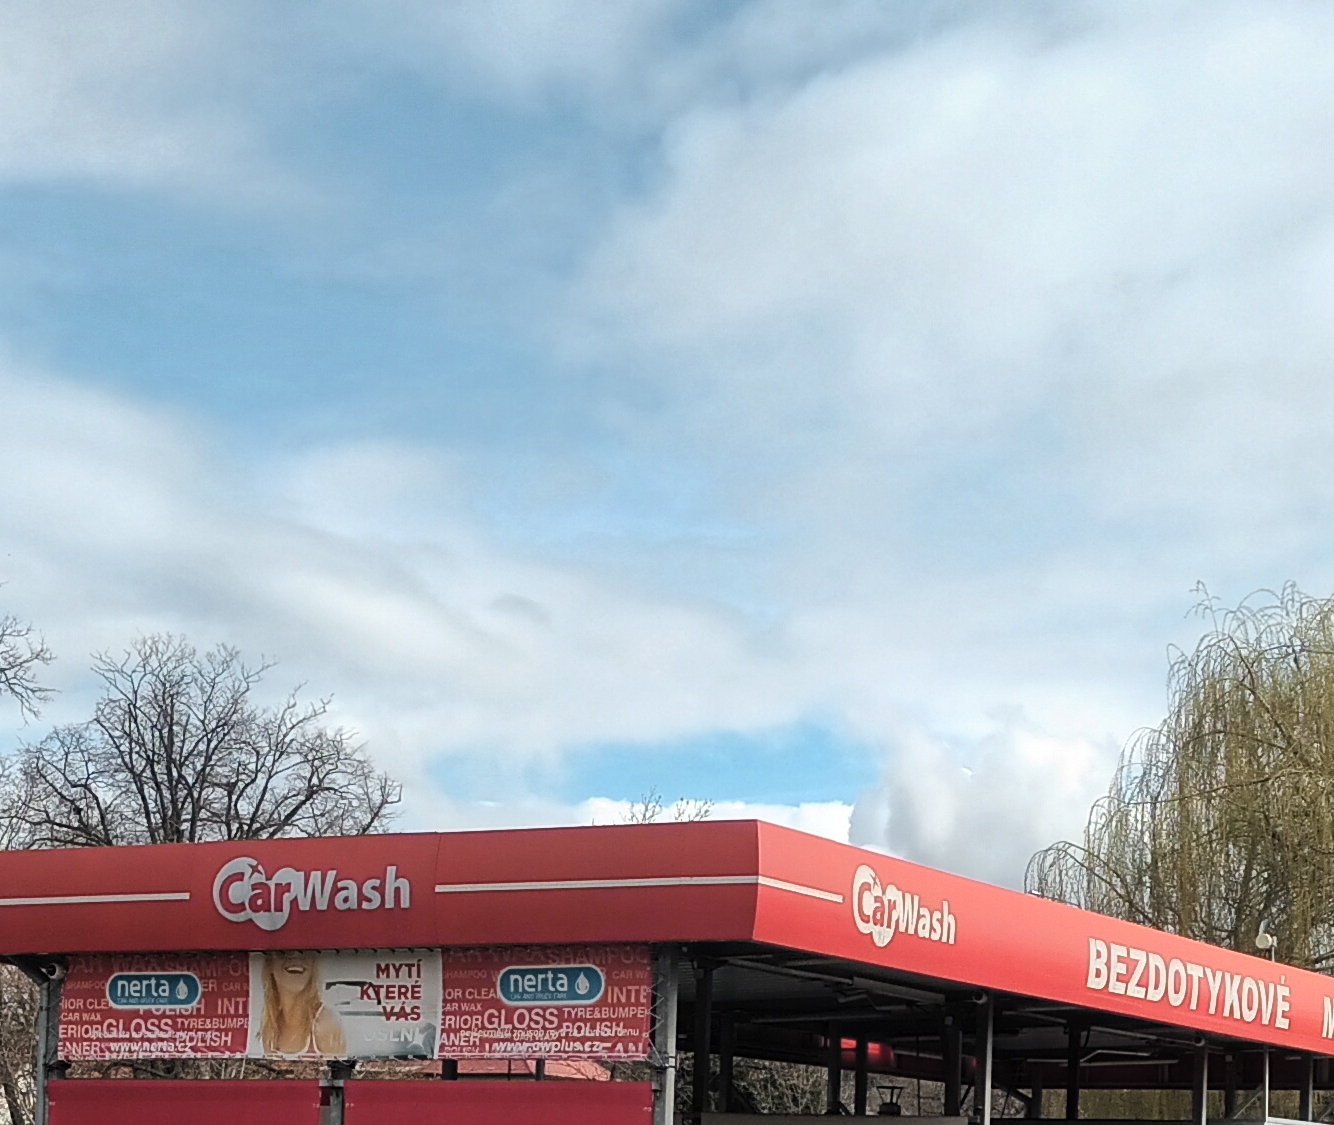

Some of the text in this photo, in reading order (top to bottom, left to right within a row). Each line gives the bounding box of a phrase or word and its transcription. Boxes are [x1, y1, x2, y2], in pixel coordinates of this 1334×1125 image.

[215, 862, 411, 918] CarWash
[855, 874, 956, 945] CarWash
[376, 959, 421, 979] MYTÍ
[118, 977, 170, 997] nerta
[360, 980, 421, 1001] KTERÉ
[510, 970, 568, 993] nerta
[1087, 936, 1291, 1030] BEZDOTYKOVÉ
[382, 1001, 421, 1022] VÁS
[483, 1009, 559, 1029] GLOSS
[103, 1018, 173, 1039] GLOSS
